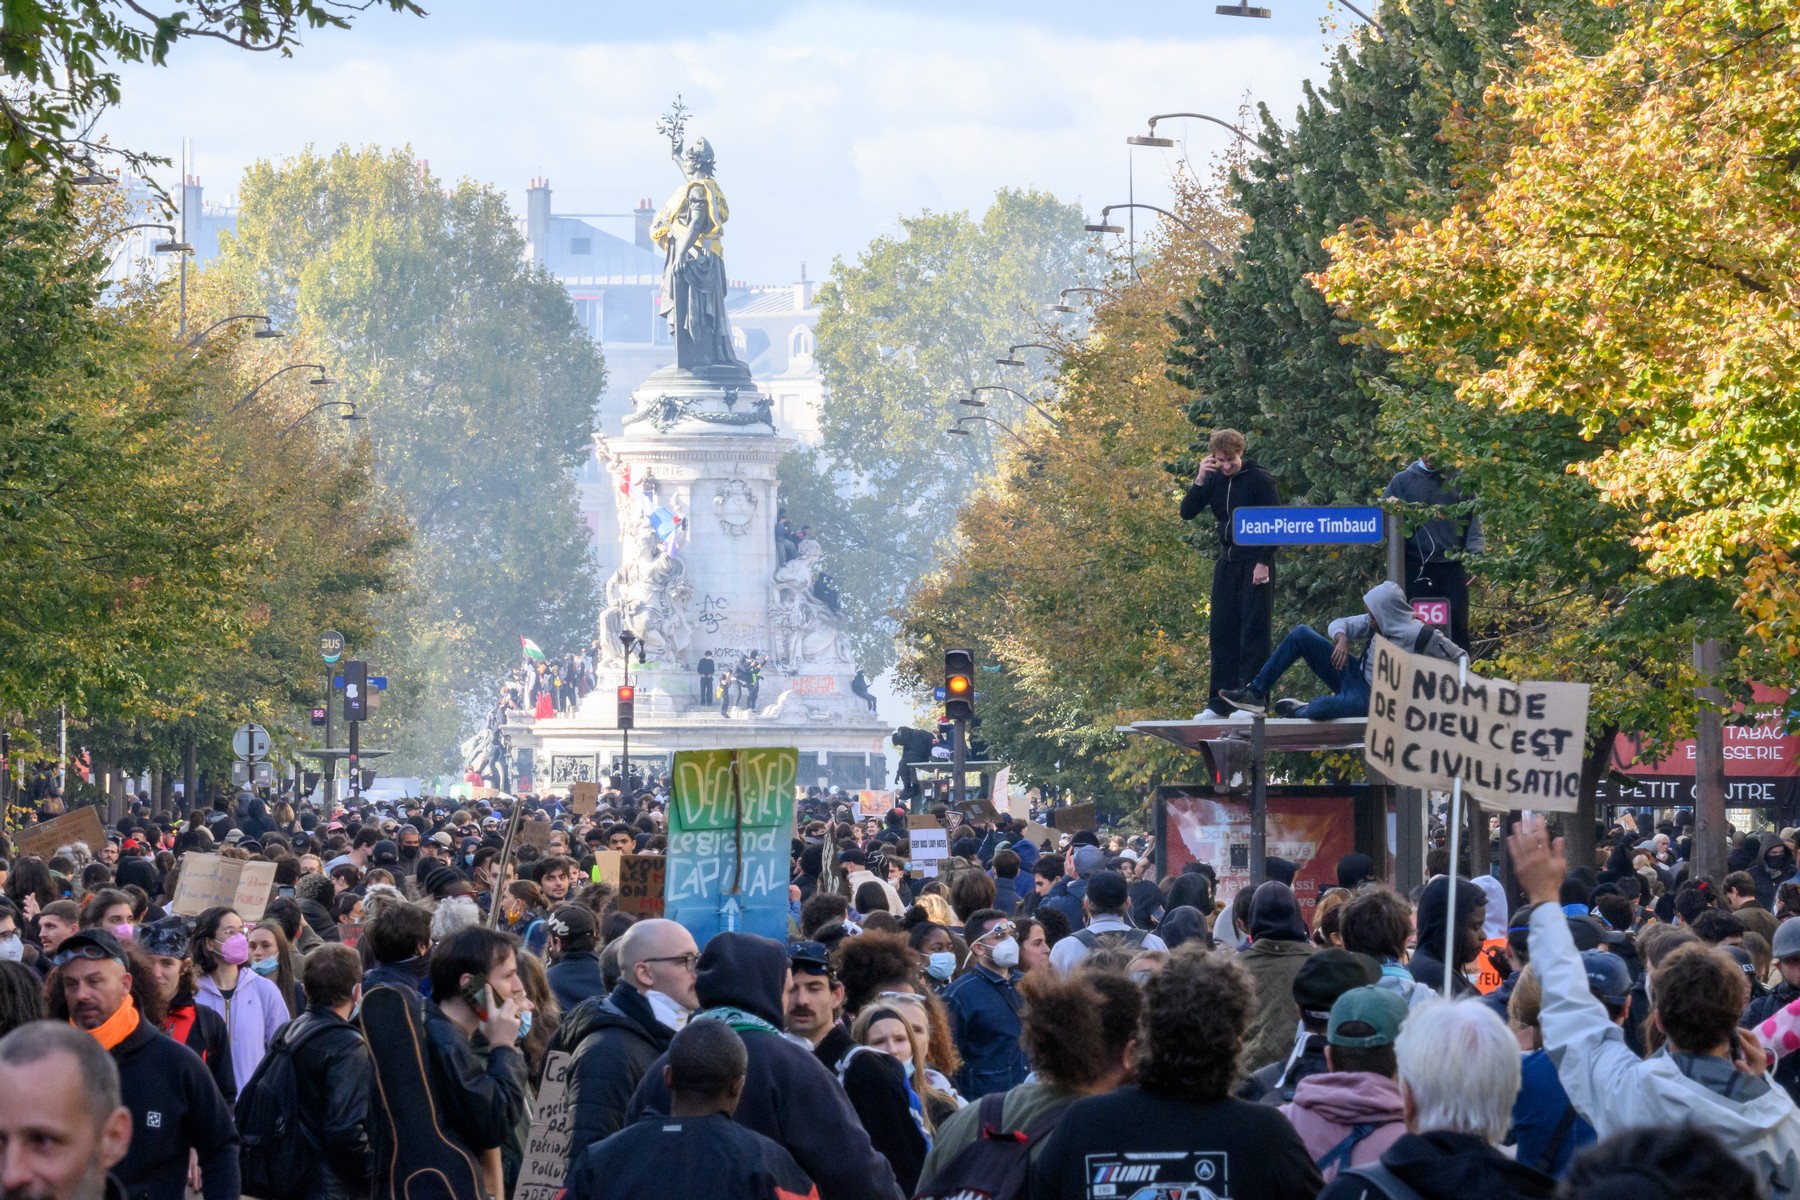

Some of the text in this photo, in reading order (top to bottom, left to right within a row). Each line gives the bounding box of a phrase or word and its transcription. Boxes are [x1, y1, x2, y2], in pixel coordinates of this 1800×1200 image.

[1240, 517, 1376, 534] Jean-Pierre Timbaud
[1417, 604, 1444, 624] 56
[321, 639, 340, 649] BUS
[1377, 649, 1546, 720] AU NOM DE
[313, 710, 324, 718] 56
[1375, 691, 1396, 722] DE
[1405, 705, 1480, 745] DIEU
[1489, 722, 1573, 757] C'EST
[1726, 725, 1784, 740] TABAC
[1686, 745, 1784, 760] BSSERIE
[1370, 729, 1394, 768] LA
[1402, 743, 1579, 798] CIVILISATIO
[1201, 829, 1250, 842] banqu
[625, 859, 665, 871] VOU
[1109, 1165, 1161, 1182] LIMIT
